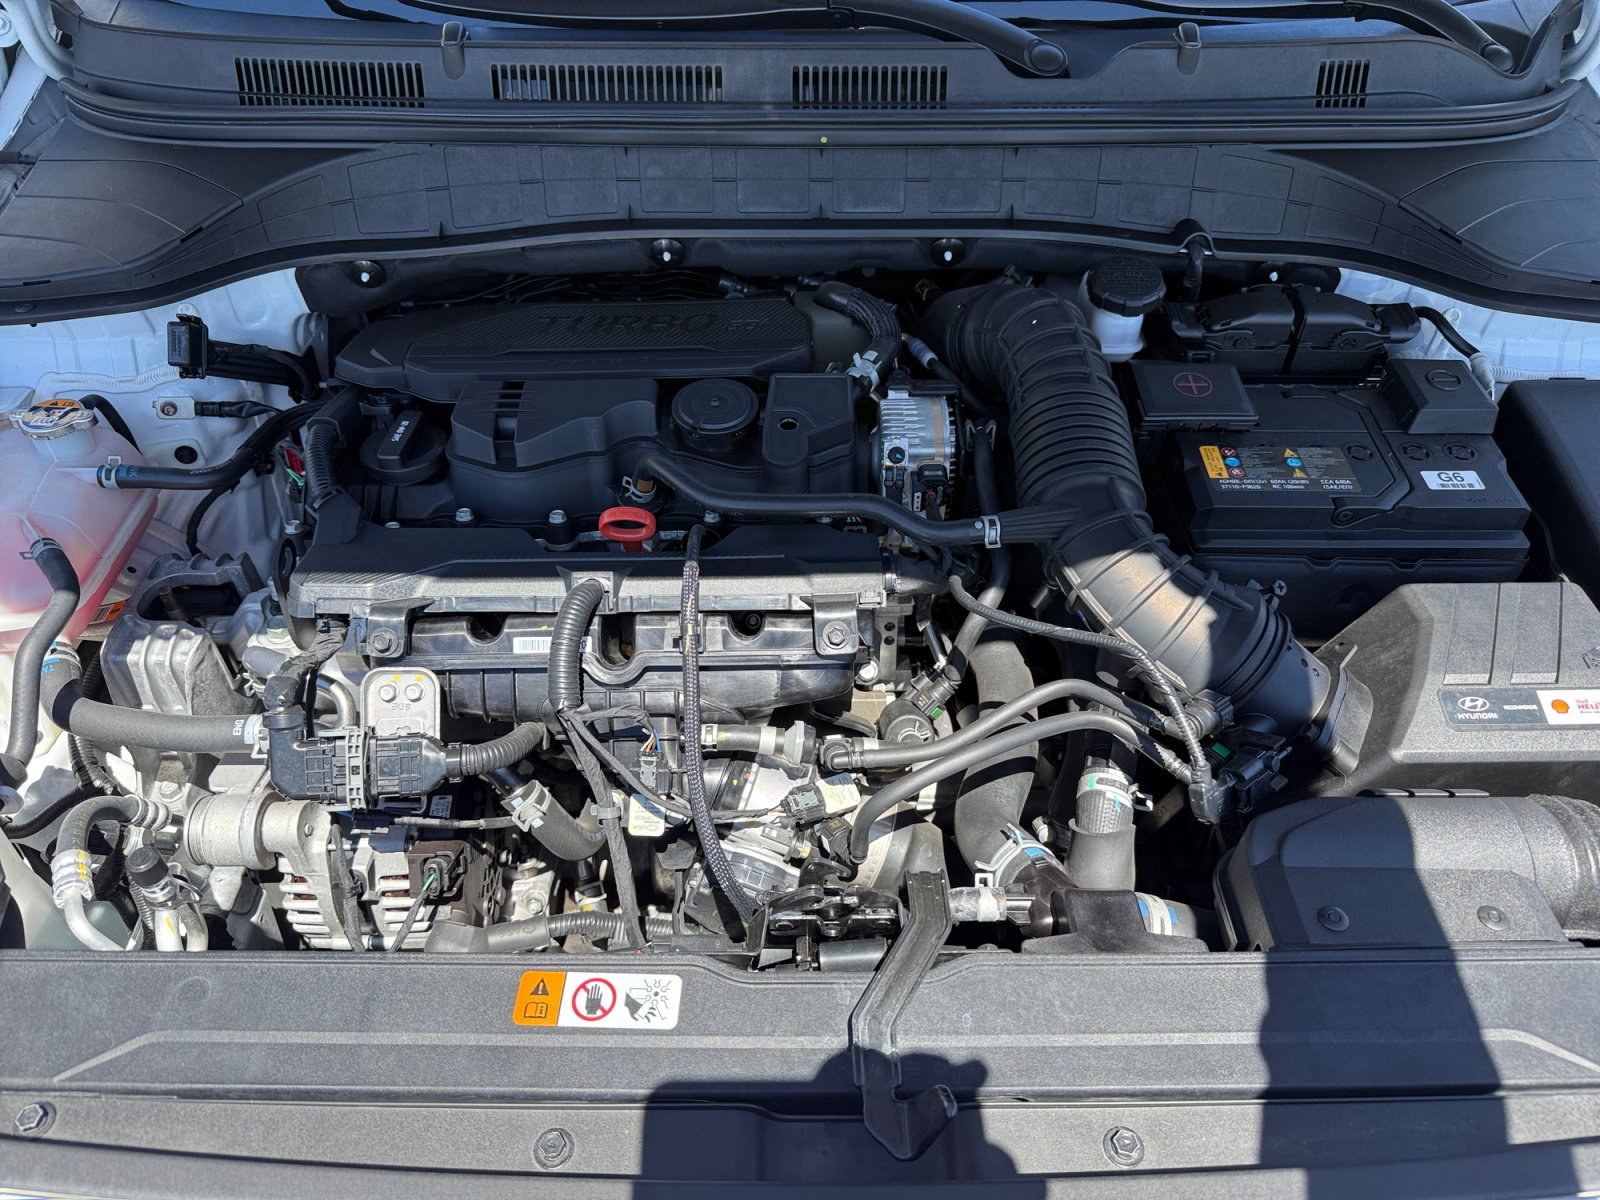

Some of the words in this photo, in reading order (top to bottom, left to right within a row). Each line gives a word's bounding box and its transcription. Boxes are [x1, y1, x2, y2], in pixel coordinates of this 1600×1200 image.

[537, 314, 719, 337] TURBO
[1437, 471, 1465, 483] G6
[1458, 712, 1498, 720] HYUNDAI
[232, 719, 245, 737] ENG
